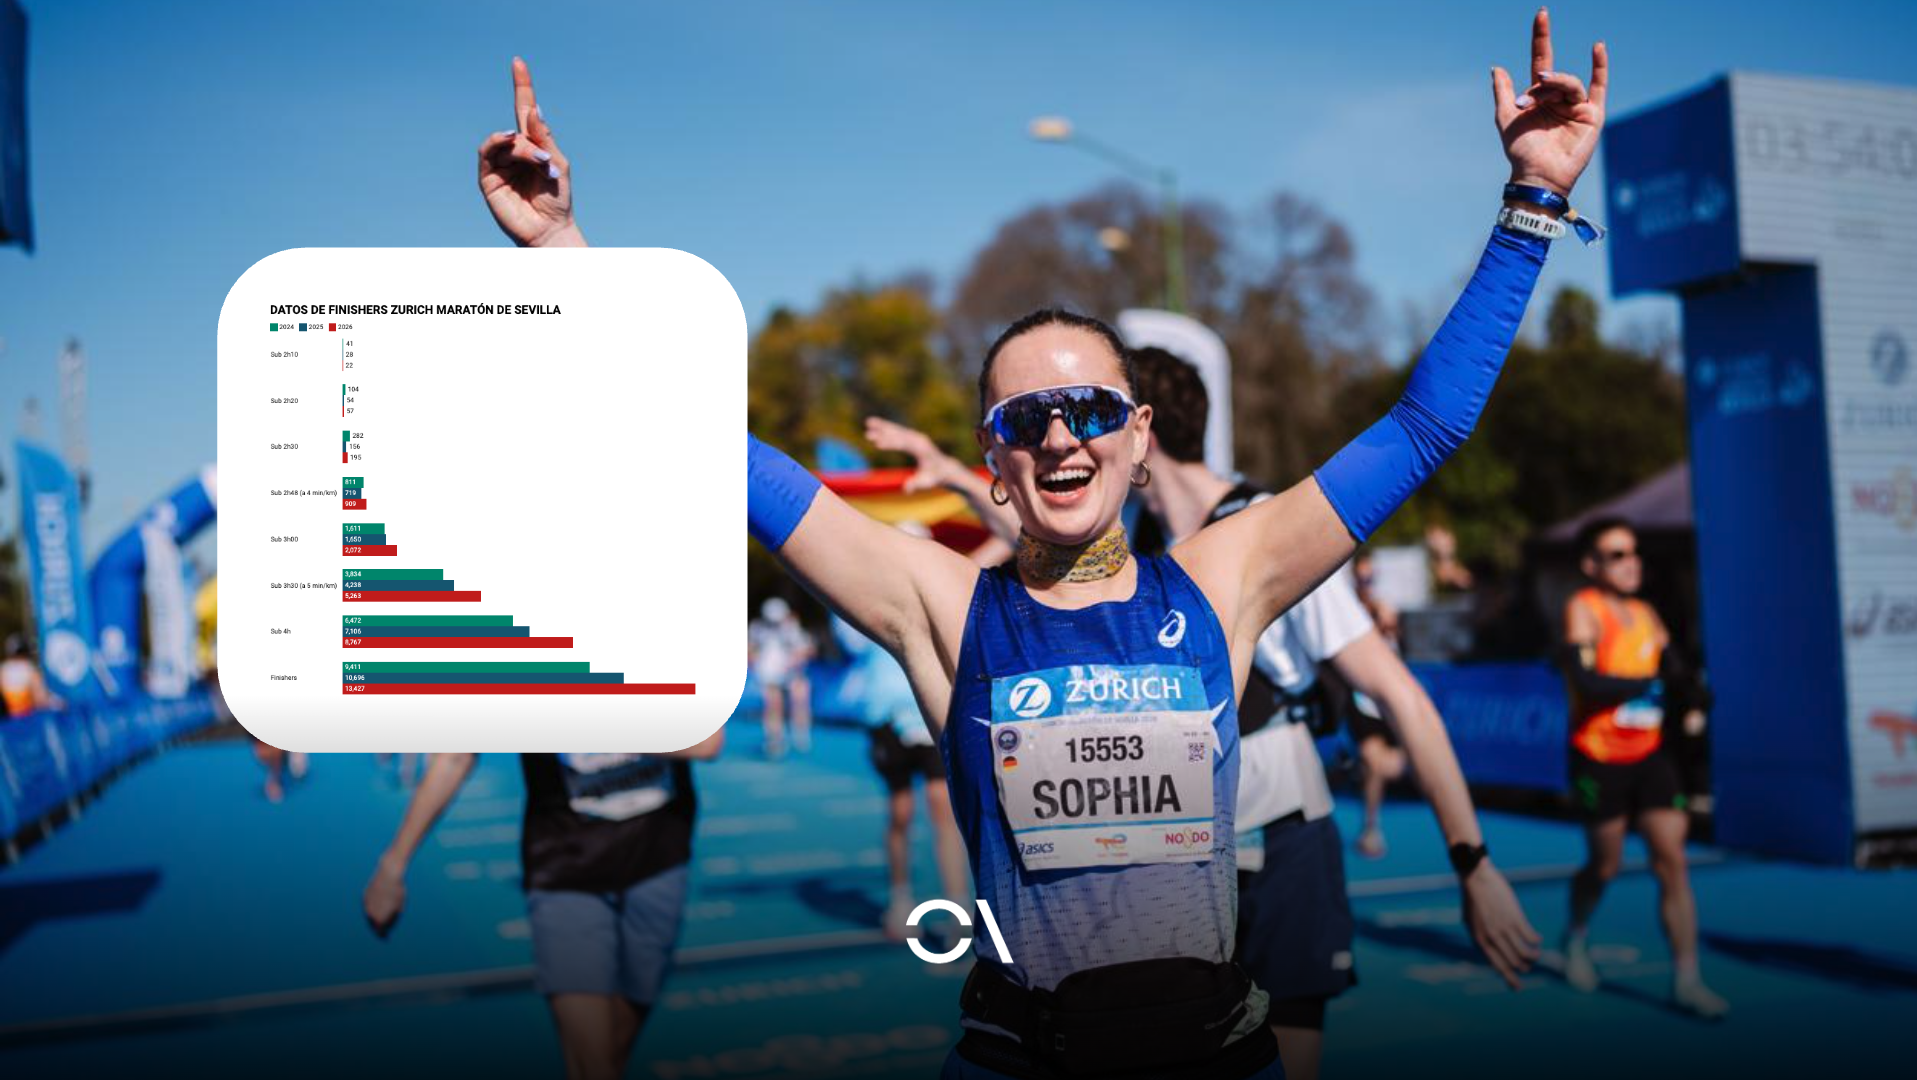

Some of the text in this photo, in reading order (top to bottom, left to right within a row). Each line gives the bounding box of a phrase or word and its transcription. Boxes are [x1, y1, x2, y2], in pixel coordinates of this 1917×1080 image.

[1066, 677, 1182, 702] ZURICH
[1066, 735, 1144, 763] 15553
[1032, 774, 1182, 819] SOPHIA
